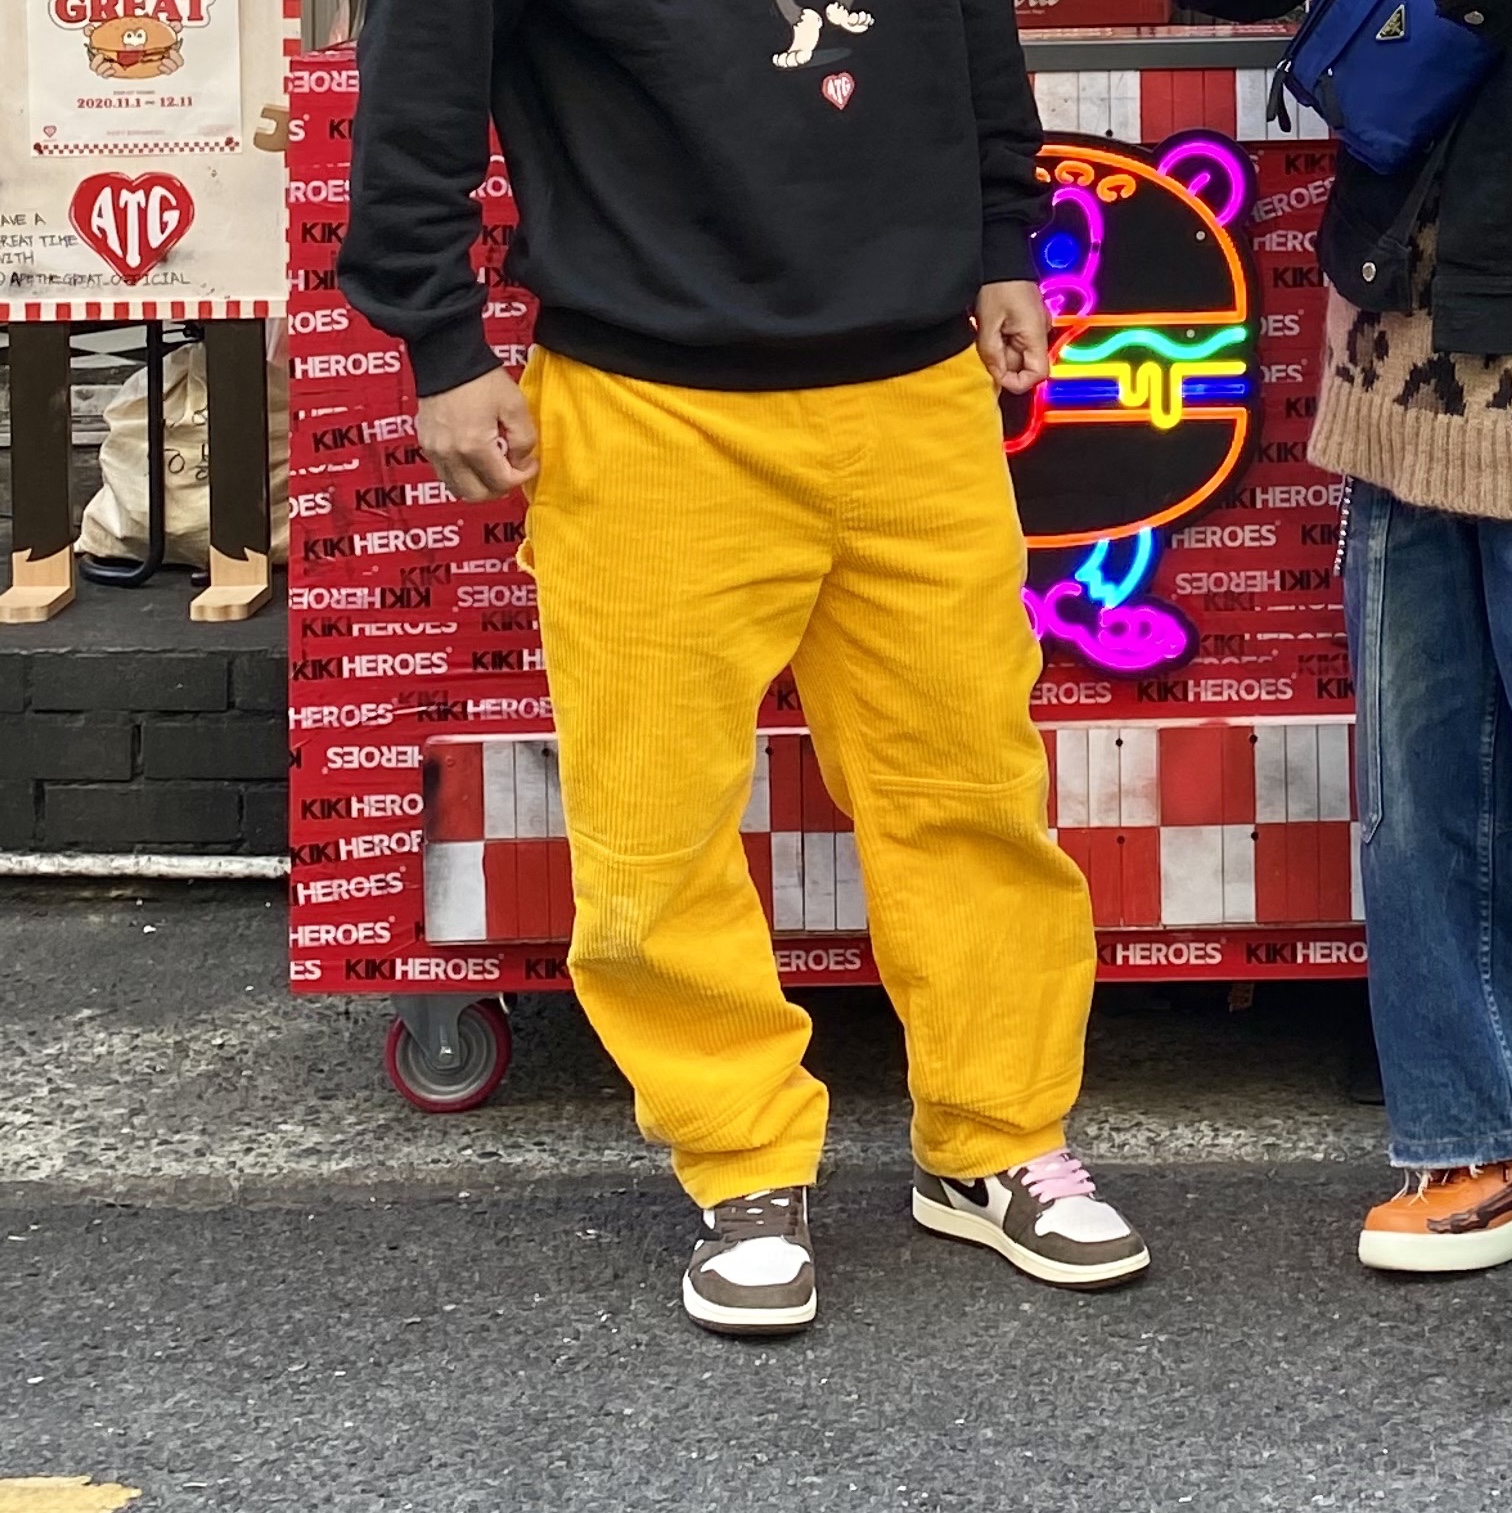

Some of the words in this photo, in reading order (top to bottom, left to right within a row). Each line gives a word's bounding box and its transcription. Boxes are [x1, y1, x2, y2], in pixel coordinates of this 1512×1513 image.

[77, 97, 142, 109] 2020.11.1
[159, 96, 193, 108] 12.11
[34, 213, 47, 226] A
[90, 185, 181, 269] ATG
[38, 235, 79, 248] TIME
[313, 414, 420, 453] KIKIHER
